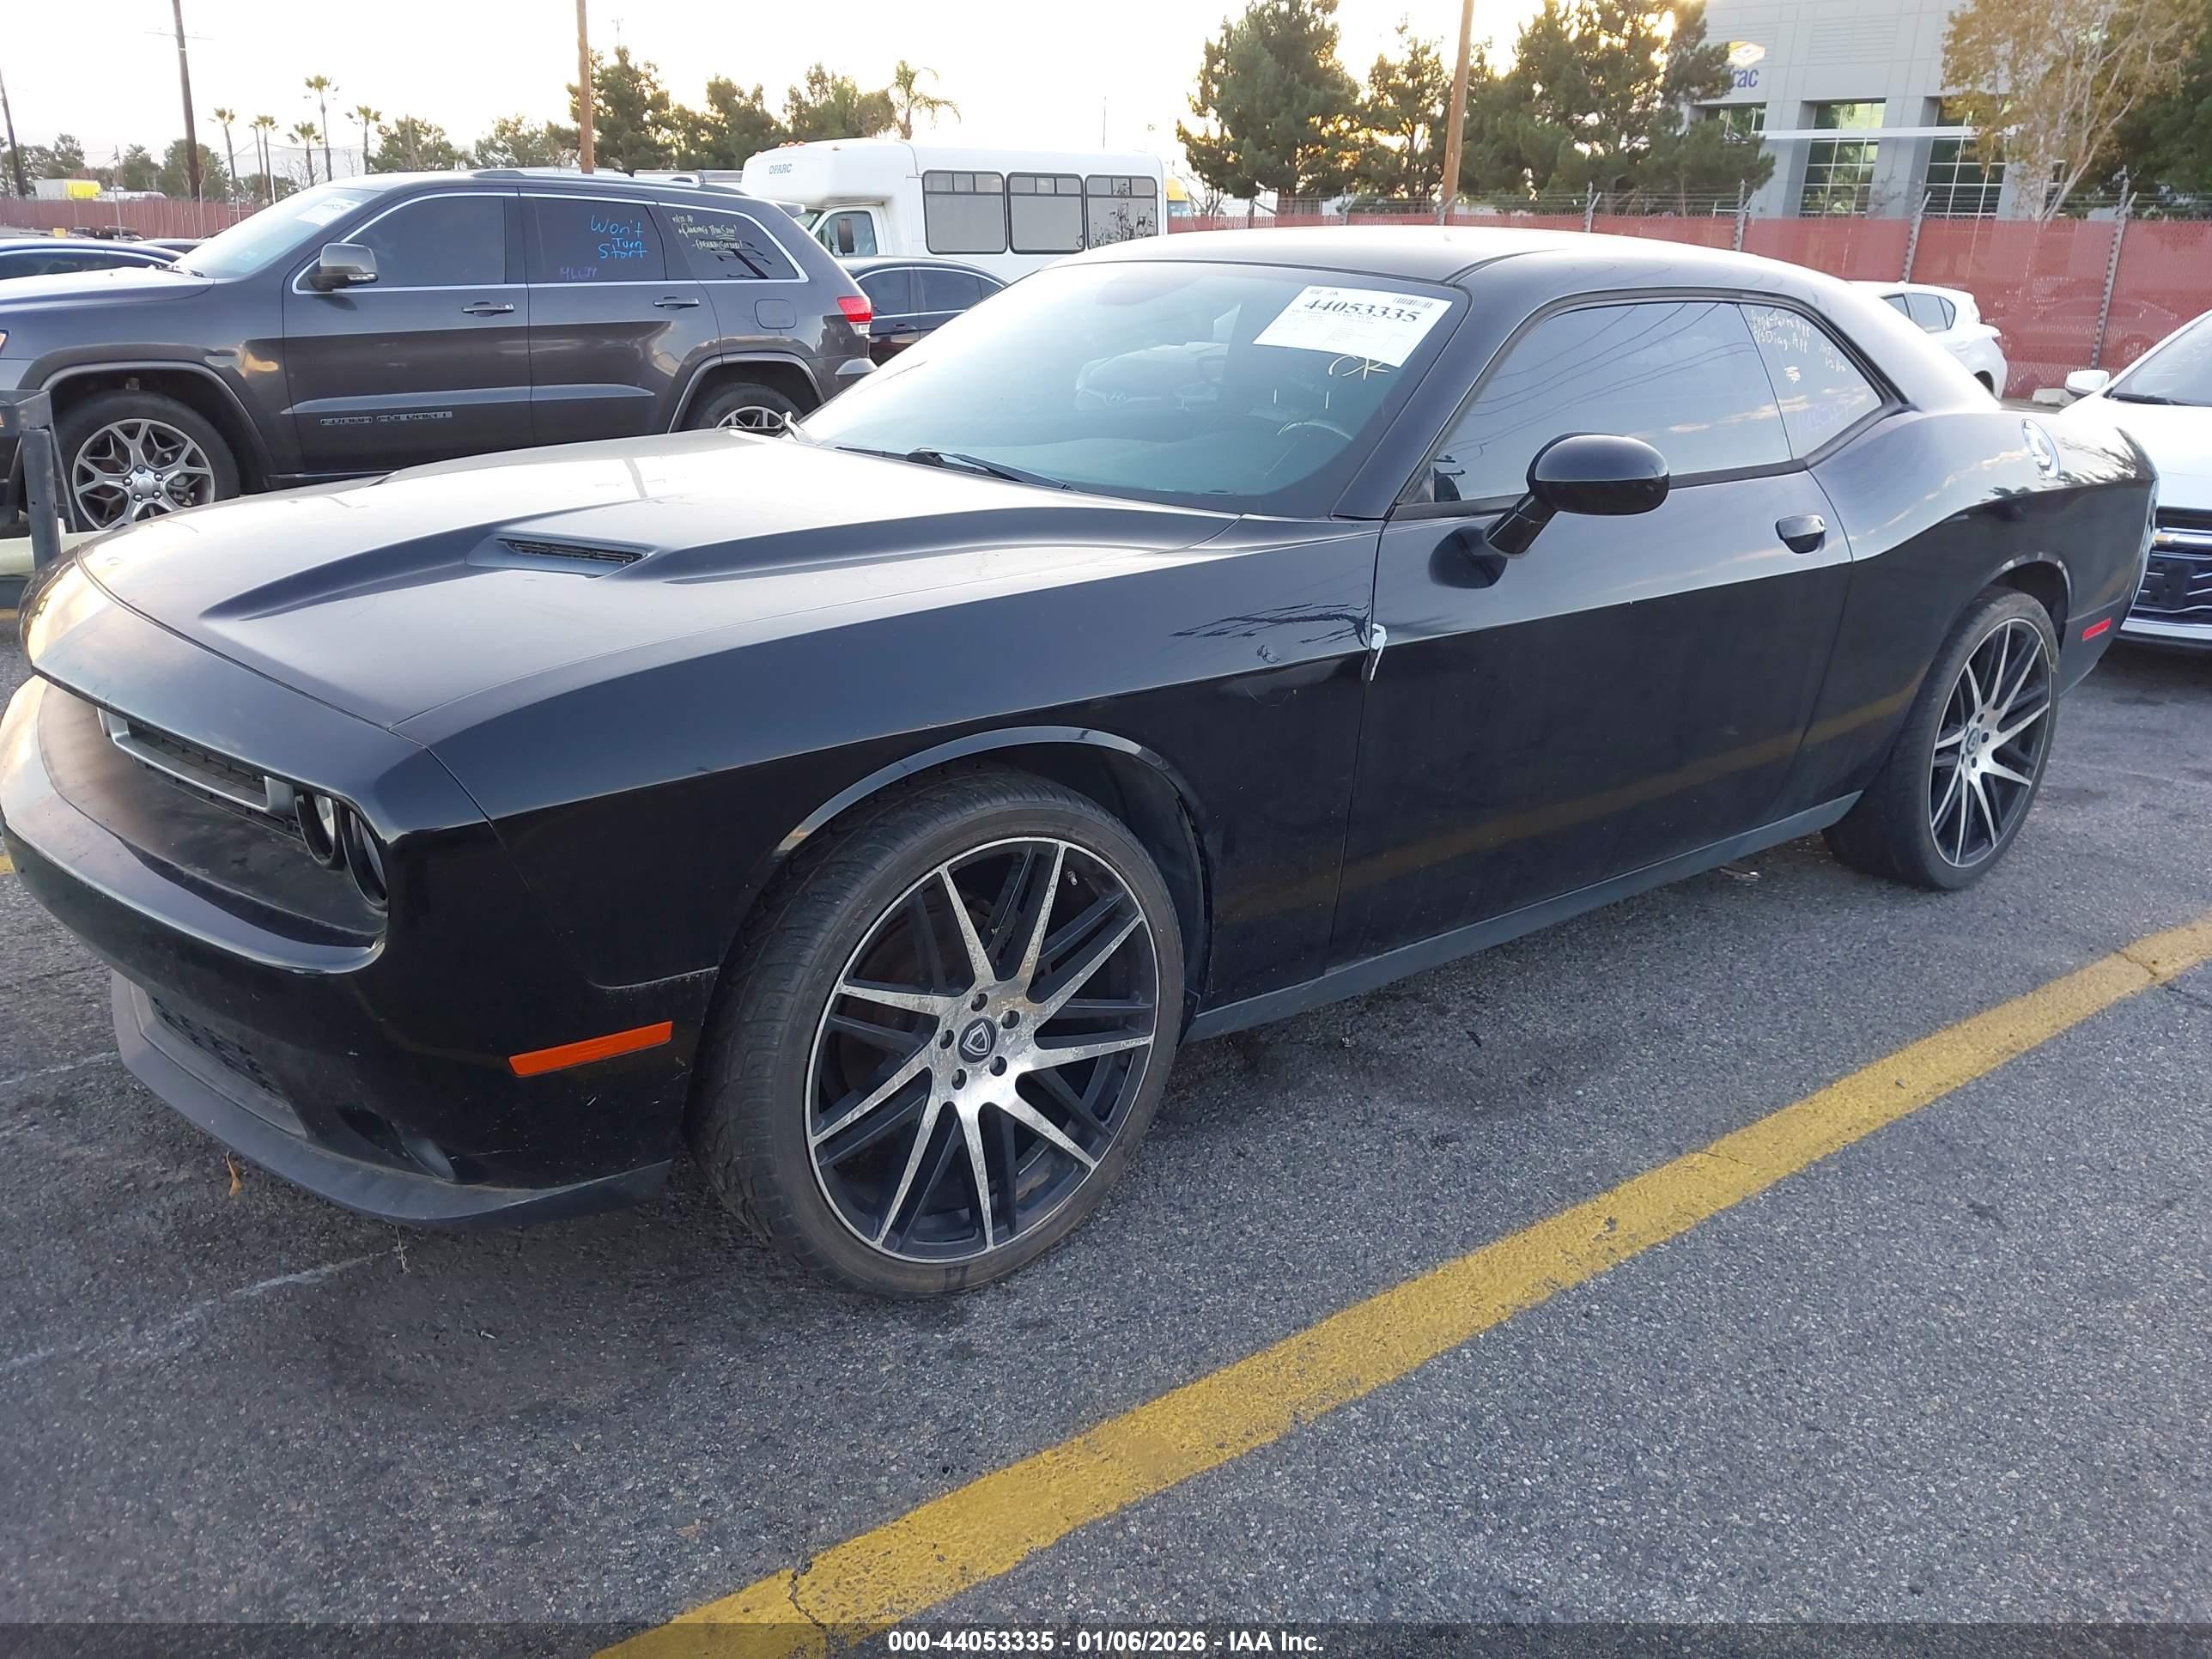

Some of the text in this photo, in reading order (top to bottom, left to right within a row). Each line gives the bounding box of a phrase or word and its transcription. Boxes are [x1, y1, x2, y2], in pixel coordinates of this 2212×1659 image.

[769, 163, 793, 174] OPARC
[590, 214, 644, 239] Won't
[598, 243, 647, 259] Start
[611, 237, 642, 250] Turn
[1304, 298, 1423, 323] 44053335
